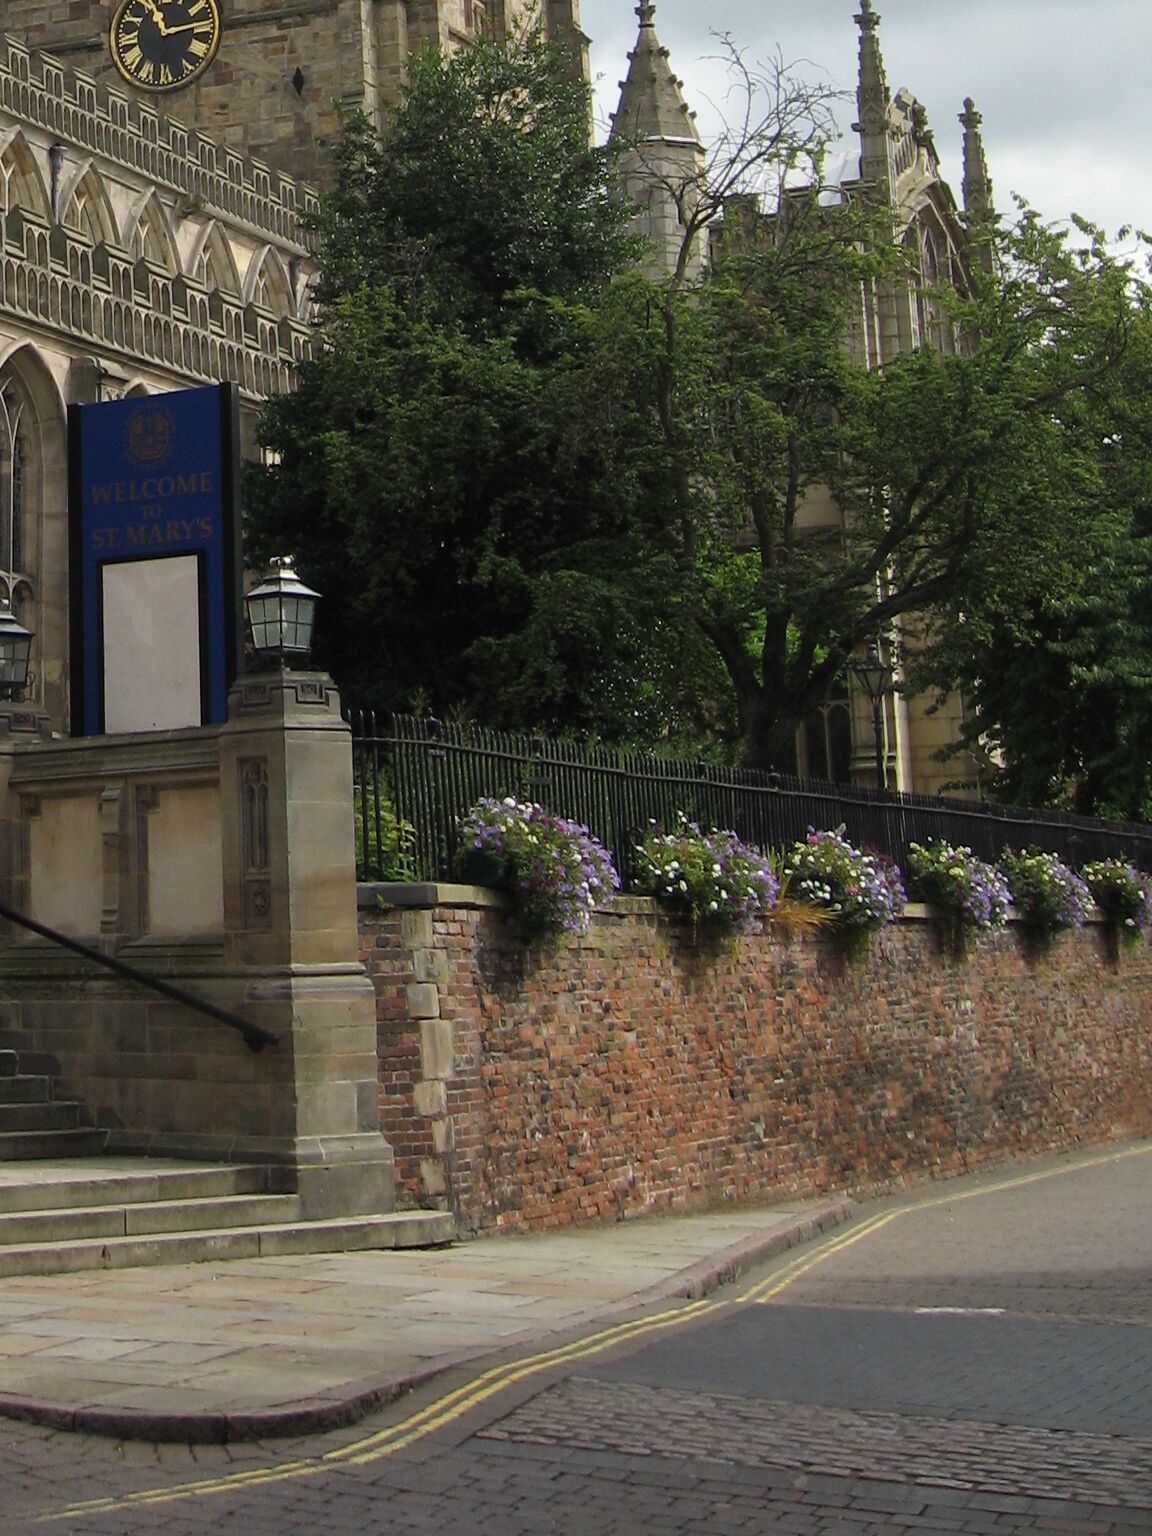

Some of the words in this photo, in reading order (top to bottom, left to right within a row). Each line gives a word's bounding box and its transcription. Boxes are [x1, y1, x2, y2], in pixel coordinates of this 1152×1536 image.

[91, 472, 212, 505] WELCOME
[141, 504, 163, 520] TO
[127, 517, 213, 545] MARY'S
